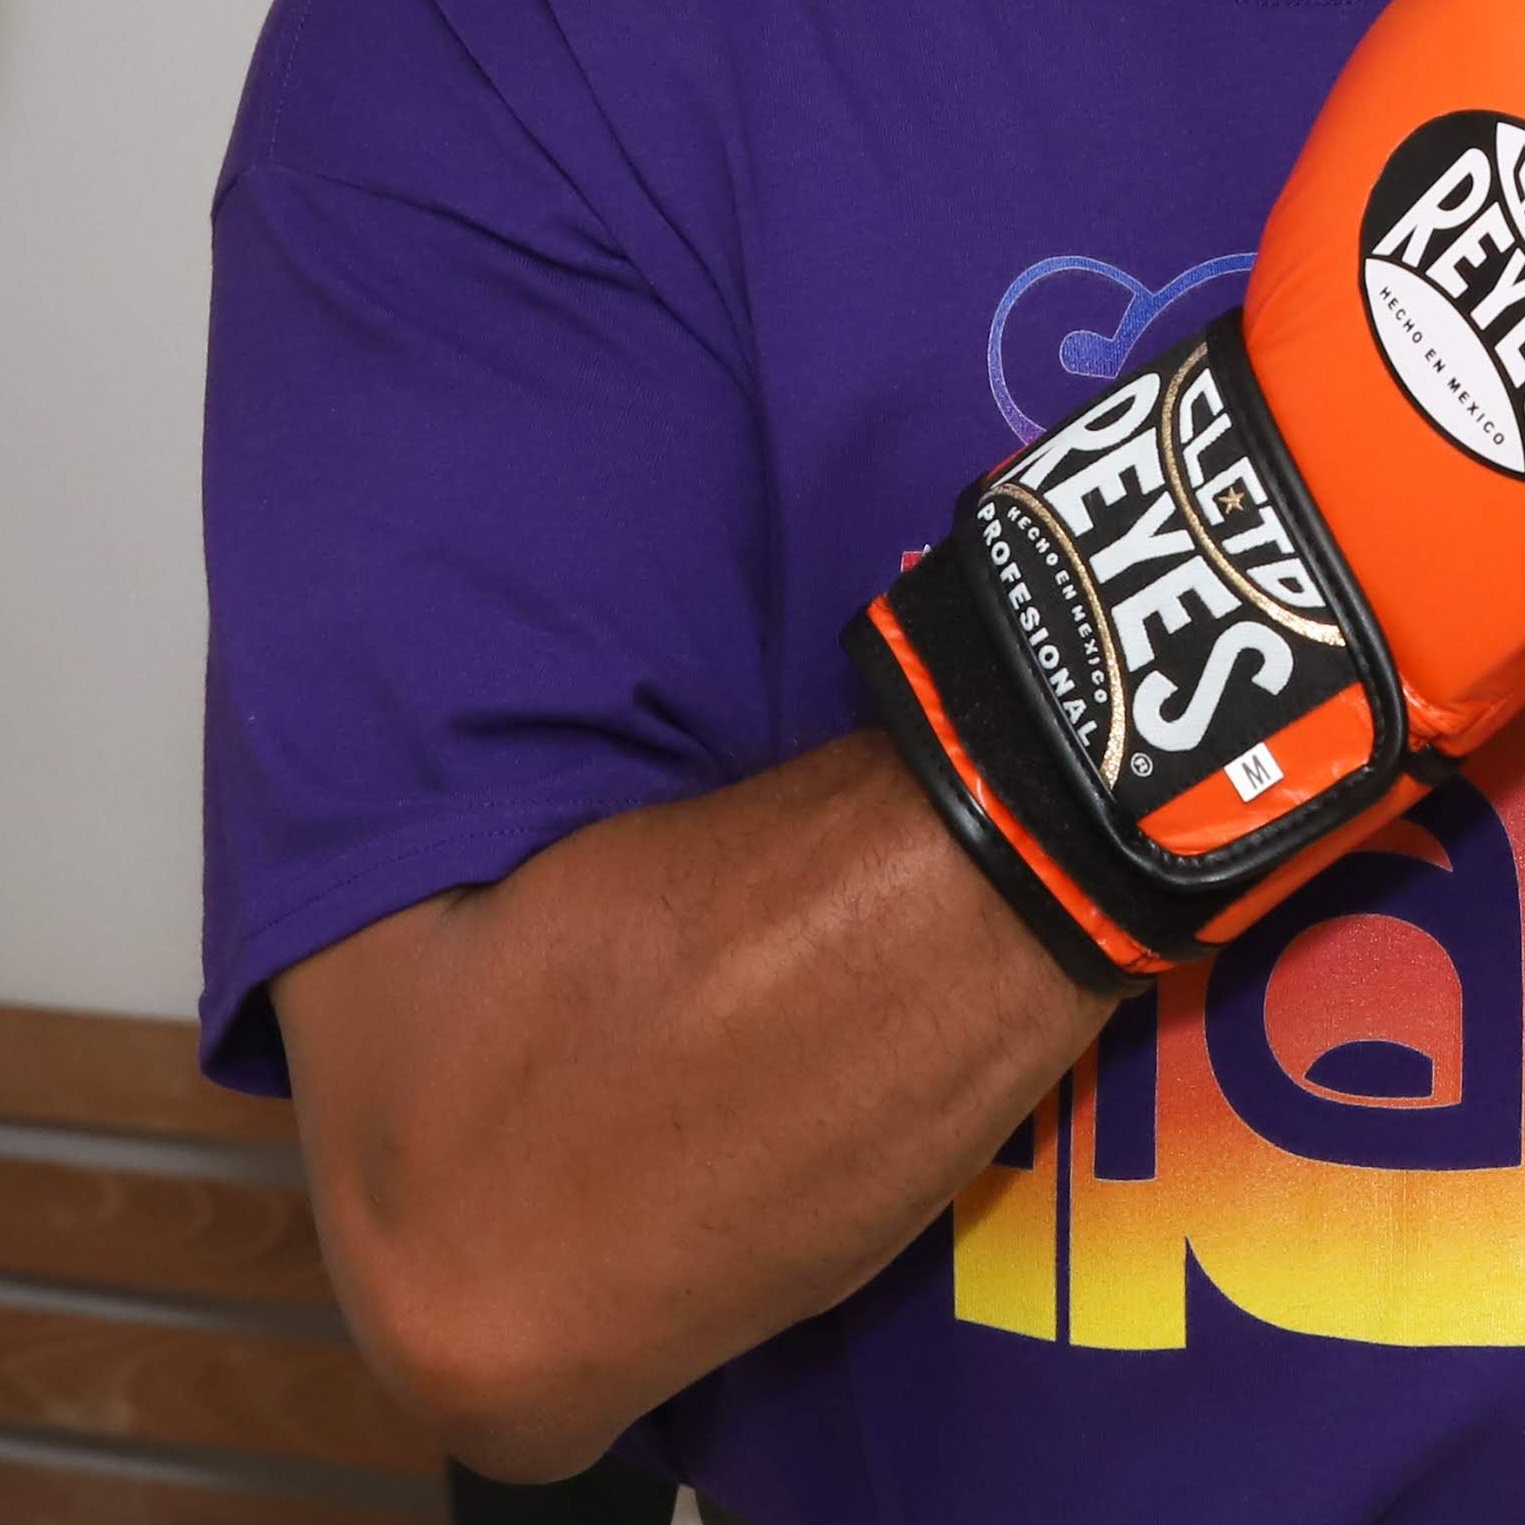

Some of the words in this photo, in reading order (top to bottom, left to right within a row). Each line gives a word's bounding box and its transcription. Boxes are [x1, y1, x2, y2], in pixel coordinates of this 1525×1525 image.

[1379, 285, 1423, 344] HECHO
[1424, 348, 1446, 373] EN
[1447, 377, 1505, 446] MEXICO
[976, 501, 1098, 748] PROFESIONAL
[987, 372, 1294, 753] REYES
[1007, 505, 1058, 567] HECHO
[1055, 569, 1074, 599] EN
[1071, 604, 1108, 704] MEXICO
[1243, 755, 1272, 790] M
